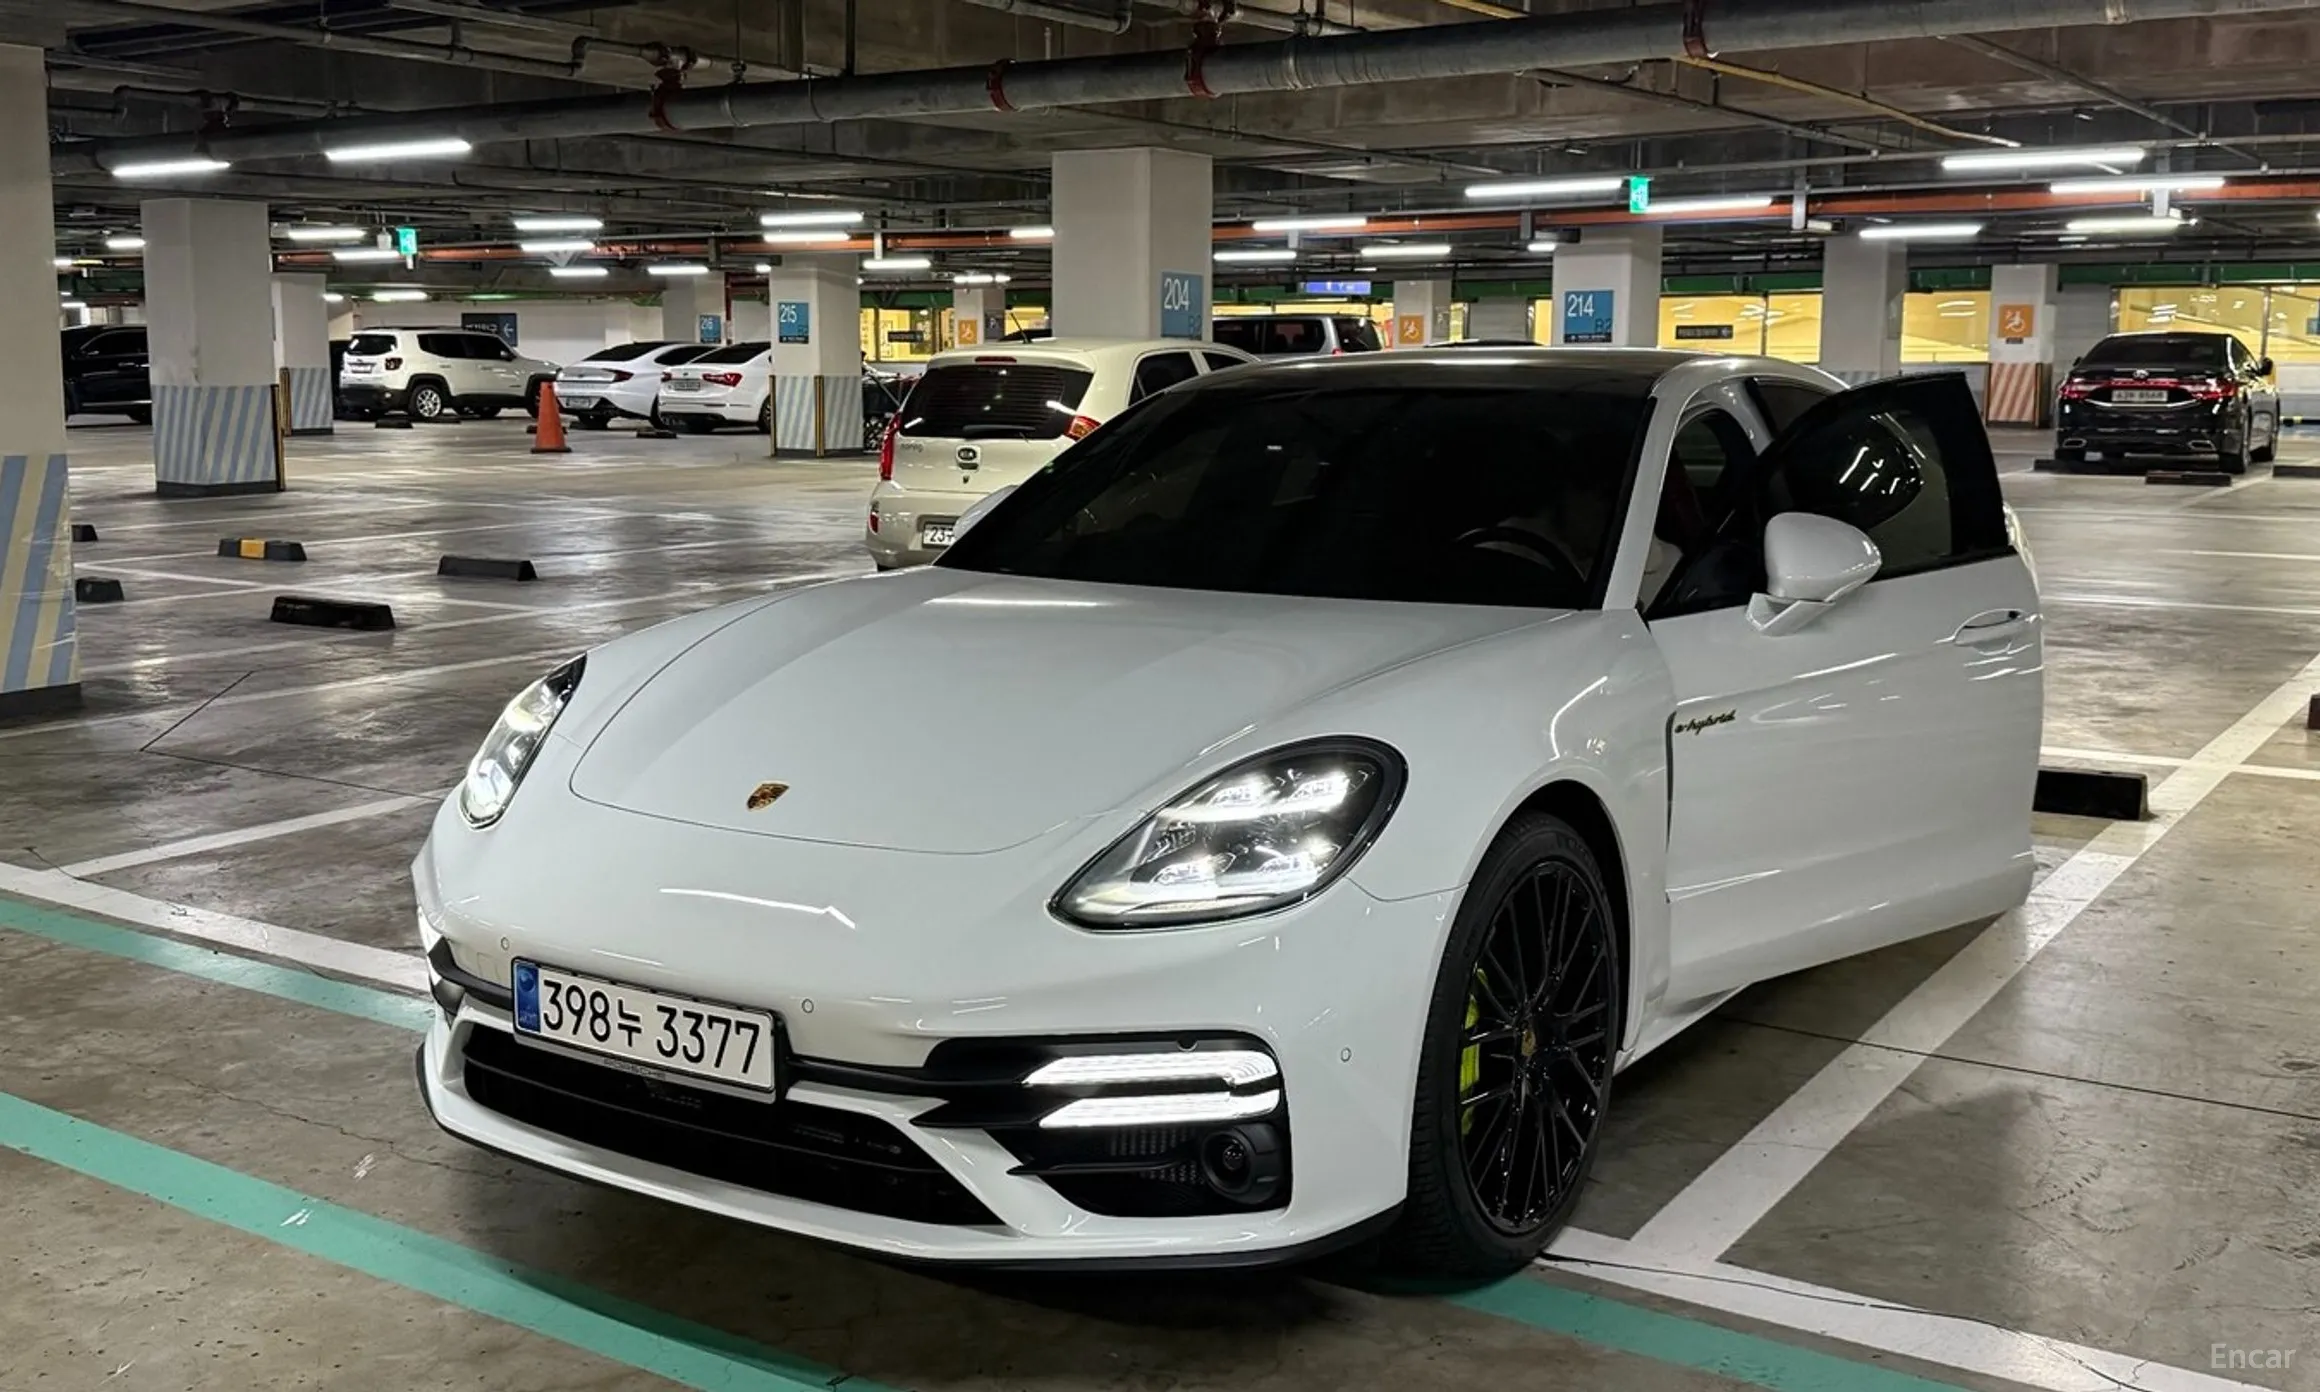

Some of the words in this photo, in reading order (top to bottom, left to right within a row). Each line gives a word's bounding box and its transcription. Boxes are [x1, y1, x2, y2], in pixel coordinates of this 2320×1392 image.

[1163, 277, 1190, 312] 204
[1567, 293, 1595, 318] 214
[779, 303, 798, 323] 215
[1674, 708, 1737, 736] e-hybrid
[543, 979, 642, 1048] 398누
[656, 1004, 760, 1074] 3377
